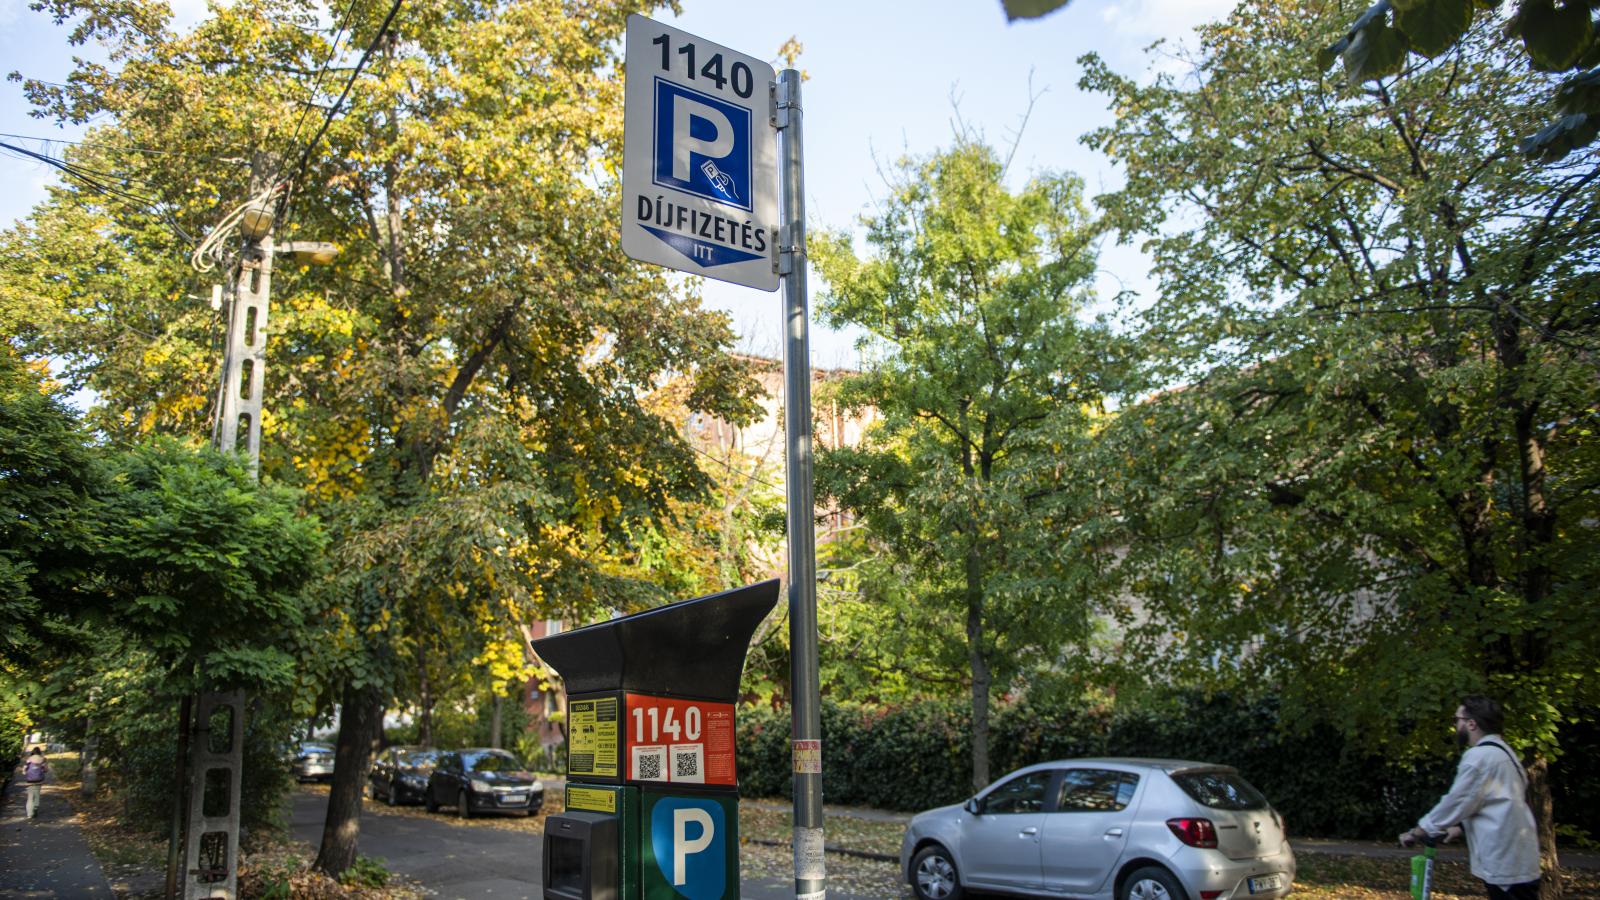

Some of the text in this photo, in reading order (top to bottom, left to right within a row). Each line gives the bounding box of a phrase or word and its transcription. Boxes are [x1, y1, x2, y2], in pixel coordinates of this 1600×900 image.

[652, 33, 754, 99] 1140
[673, 94, 735, 182] P
[637, 194, 767, 252] DÍJFIZETÉS
[693, 243, 714, 261] ITT
[632, 706, 701, 743] 1140
[673, 807, 715, 886] P
